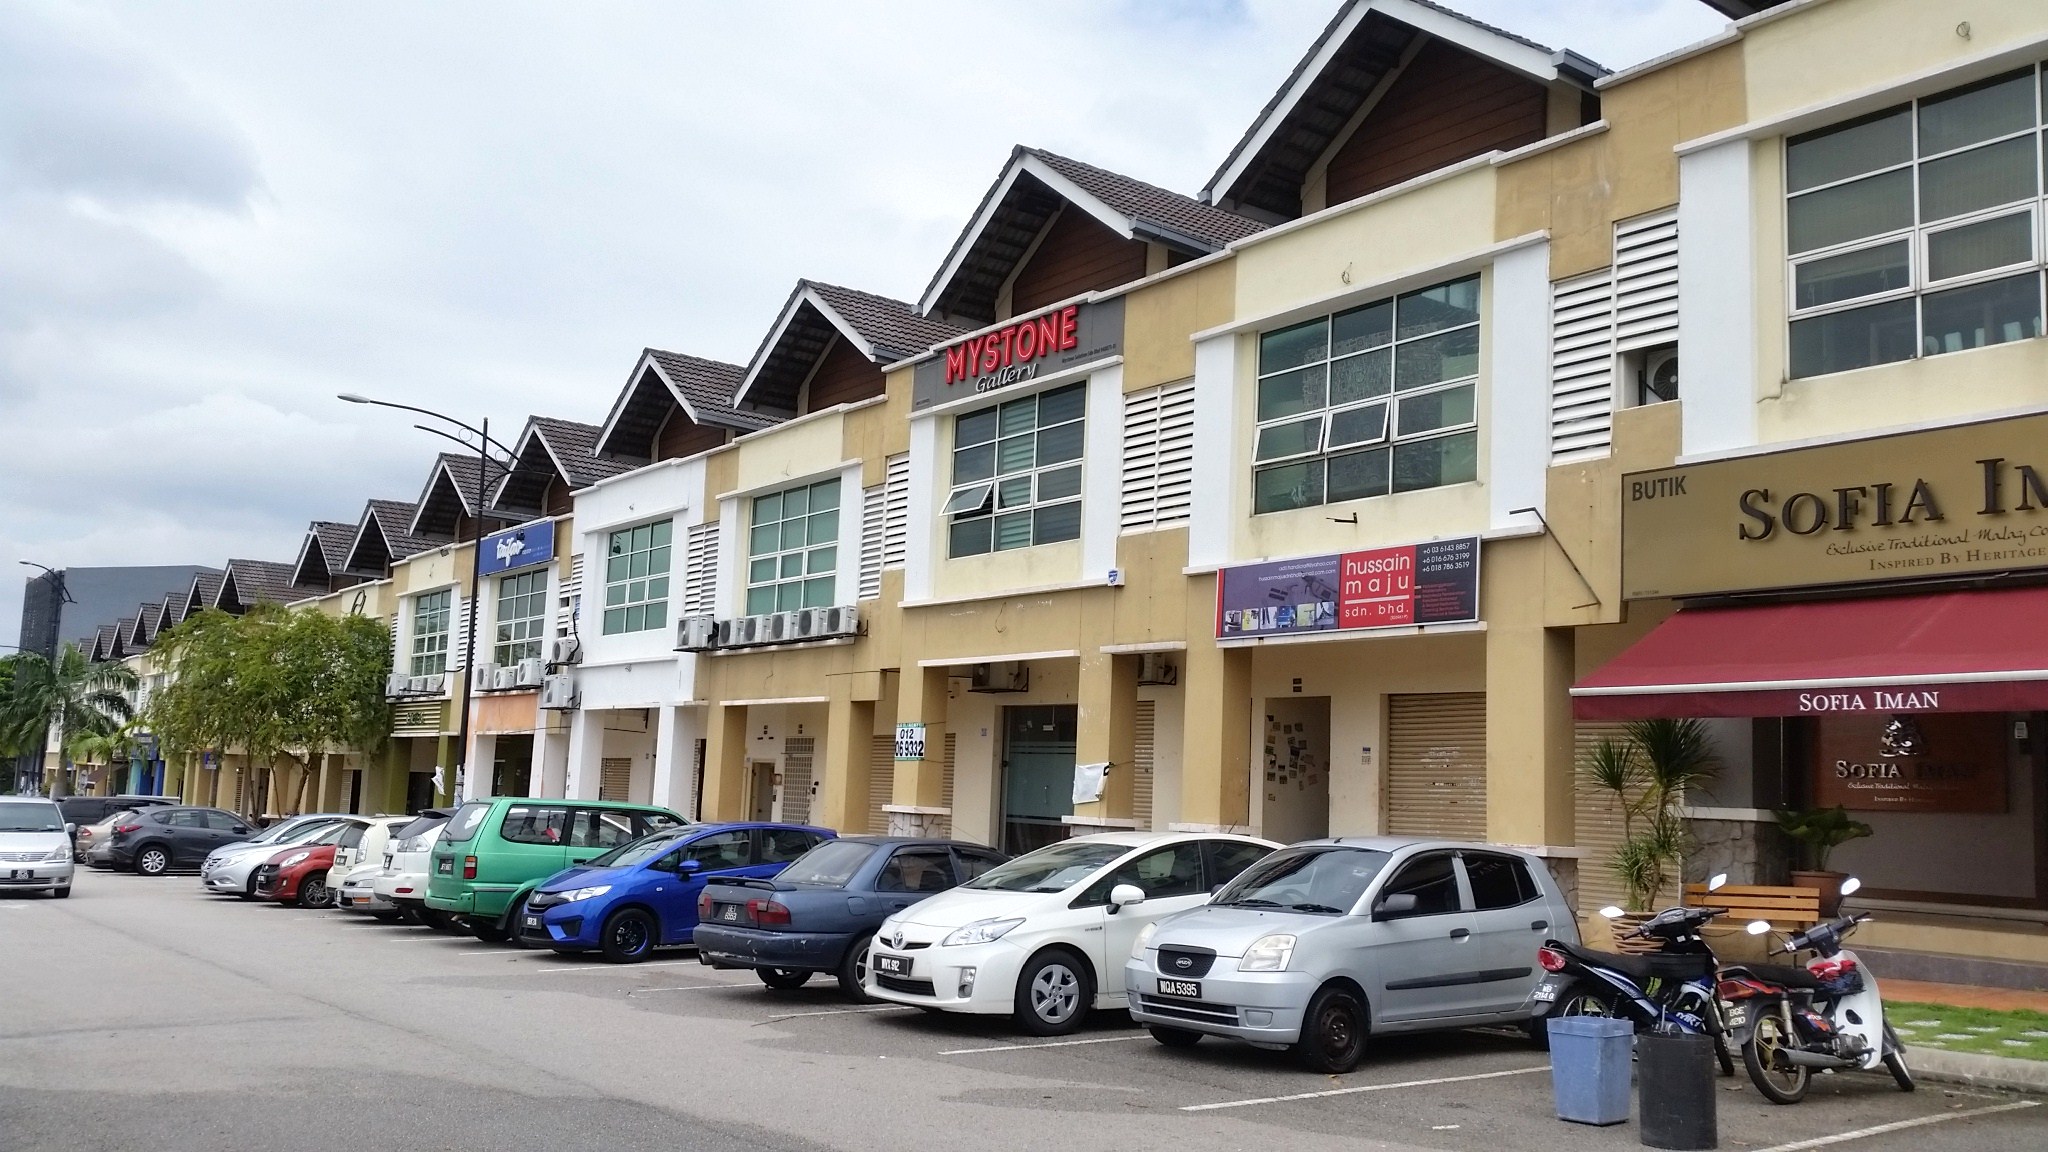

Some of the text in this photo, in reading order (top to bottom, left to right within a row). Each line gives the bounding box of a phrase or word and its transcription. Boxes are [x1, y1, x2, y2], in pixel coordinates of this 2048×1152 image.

[946, 304, 1078, 385] MYSTONE
[975, 362, 1039, 394] Gallery
[1631, 475, 1687, 502] BUTIK
[1739, 478, 1945, 541] SOFIA
[1826, 541, 1886, 557] Exclusive
[1887, 528, 1969, 551] Traditional
[1974, 525, 2027, 546] Malay
[1346, 553, 1410, 576] hussain
[1454, 552, 1470, 560] 3199
[1966, 546, 2047, 563] HERITAGE
[1430, 564, 1442, 572] 018
[1454, 560, 1470, 569] 3519
[1345, 573, 1409, 595] maju
[1345, 602, 1409, 618] sdn. bhd.
[1799, 690, 1940, 712] SOFIA IMAN
[900, 728, 914, 740] 012
[1836, 760, 1901, 779] SOFIA
[1160, 980, 1198, 997] WQA 5395
